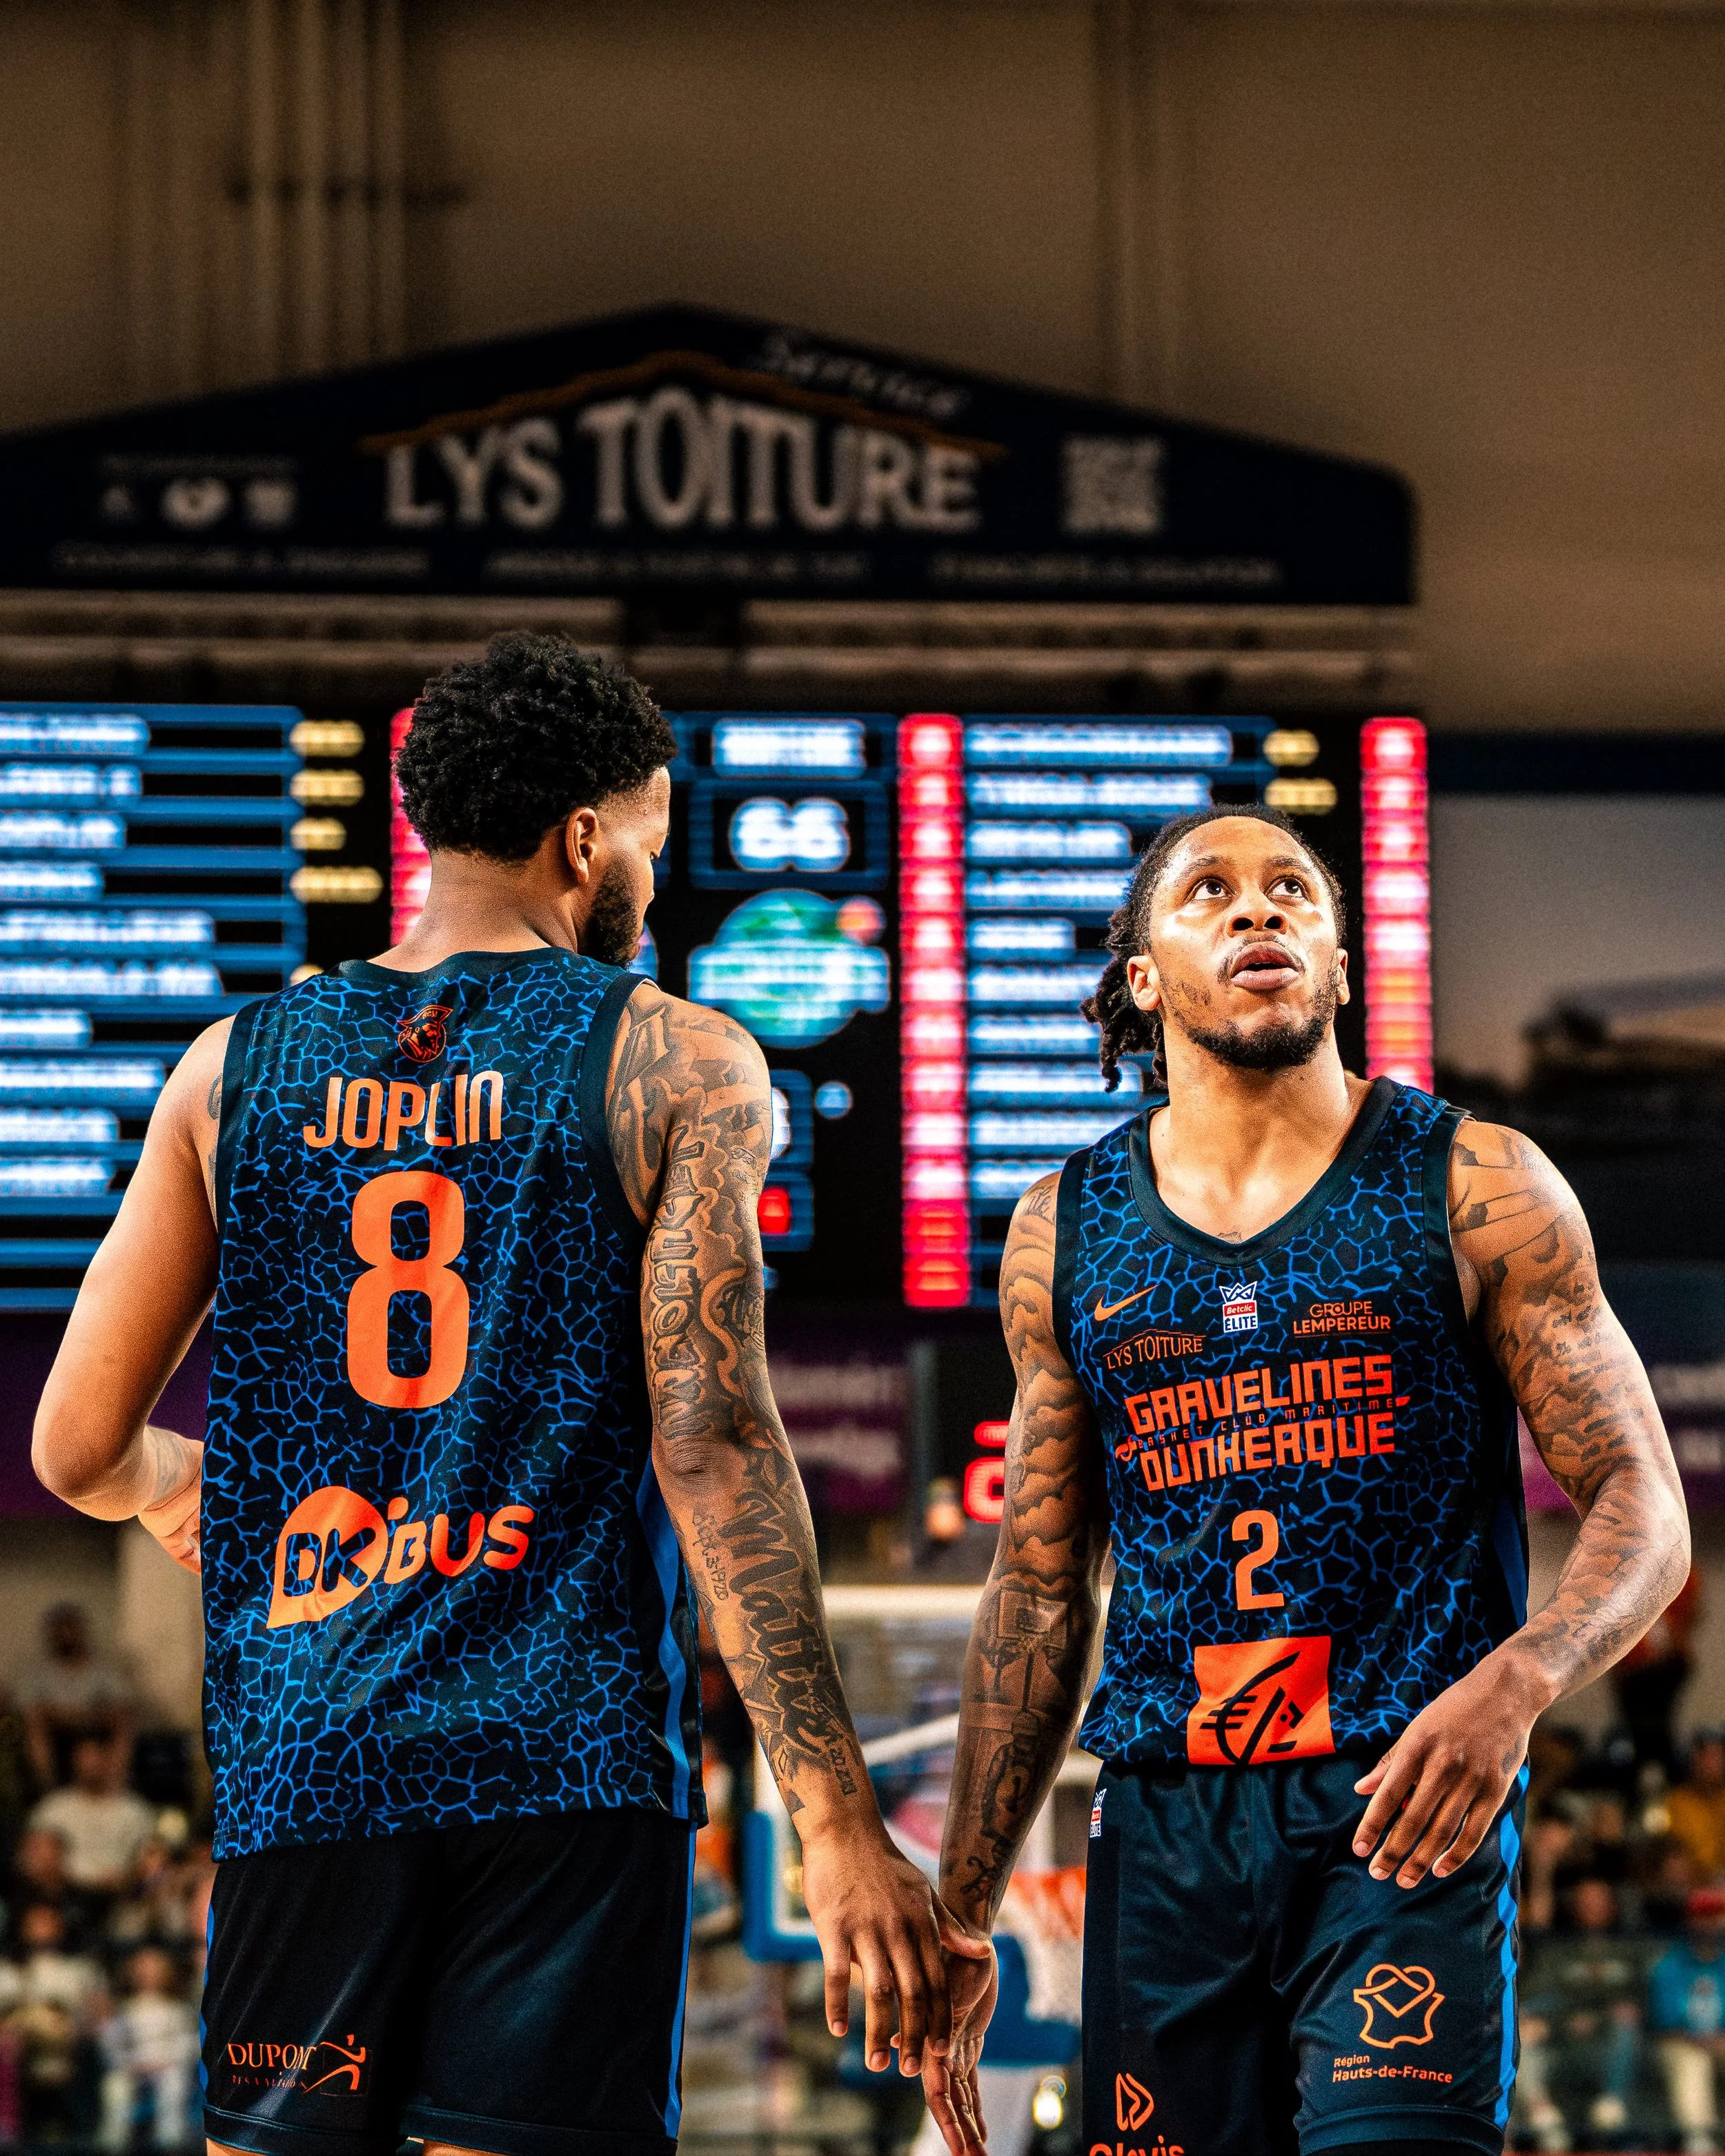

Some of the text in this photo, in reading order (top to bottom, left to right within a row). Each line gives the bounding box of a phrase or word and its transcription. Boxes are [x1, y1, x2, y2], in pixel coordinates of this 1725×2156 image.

[385, 385, 980, 531] LYS TOITURE
[303, 1070, 504, 1151] JOPLIN
[347, 1171, 470, 1408] 8
[1226, 1304, 1253, 1315] Betclic
[1309, 1300, 1373, 1318] GROUPE
[1293, 1316, 1391, 1334] LEMPEREUR
[1107, 1336, 1203, 1369] LYS TOITURE
[1221, 1414, 1265, 1432] CLUB
[1232, 1510, 1284, 1610] 2
[1333, 2055, 1370, 2068] Région
[1332, 2065, 1453, 2084] Hauts-de-France
